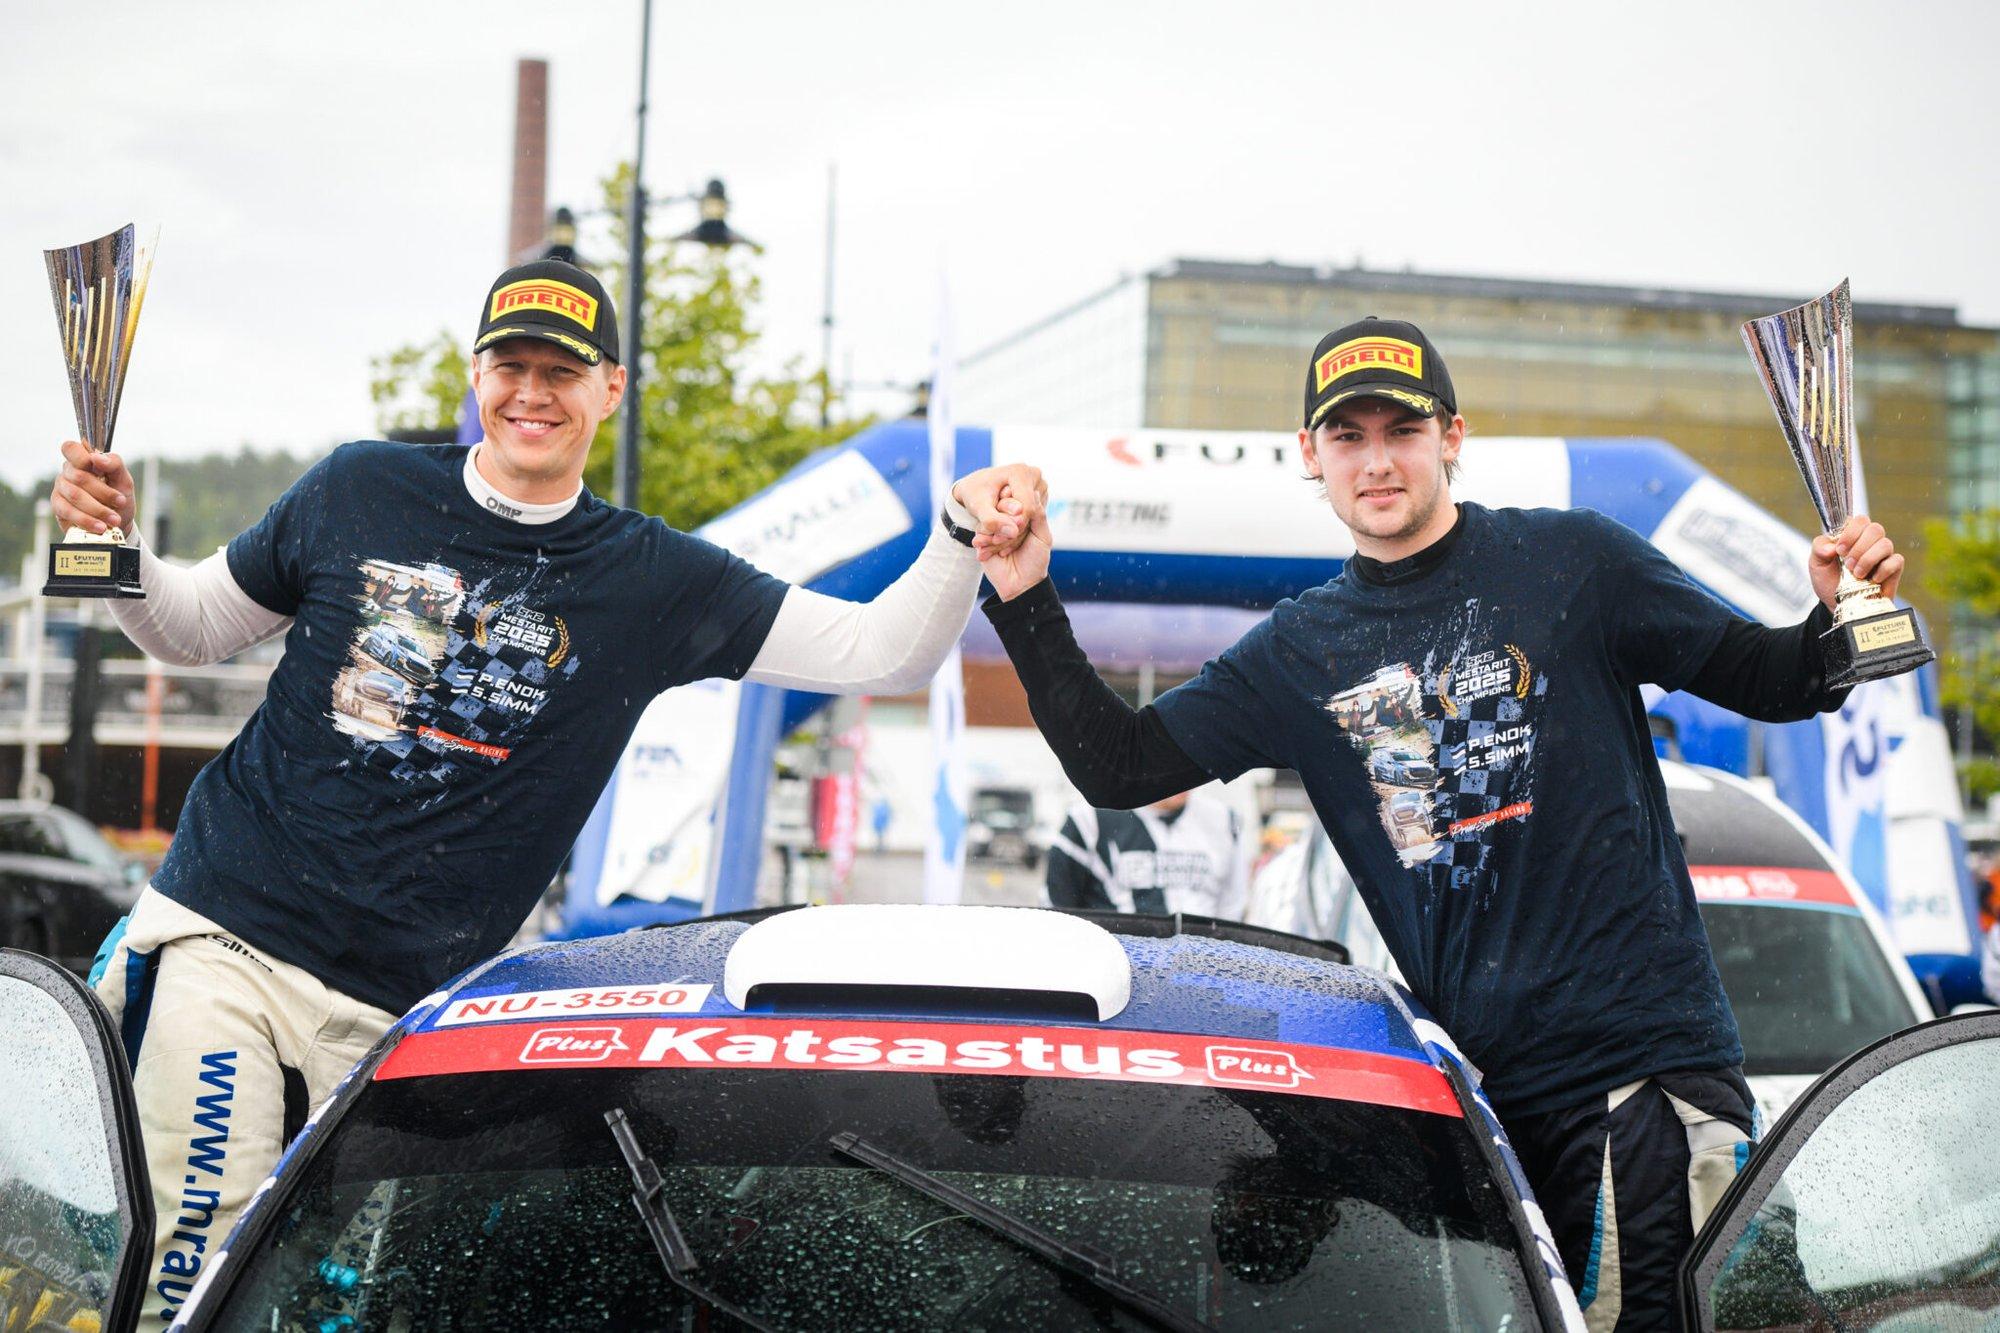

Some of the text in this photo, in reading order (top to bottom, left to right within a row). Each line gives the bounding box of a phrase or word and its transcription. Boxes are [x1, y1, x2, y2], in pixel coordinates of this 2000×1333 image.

[496, 285, 591, 321] PIRELLI
[1322, 342, 1415, 382] PIRELLI
[1155, 441, 1298, 466] FUT
[486, 496, 522, 518] OMP
[493, 620, 552, 648] 2025
[500, 612, 556, 635] MESTARIT
[489, 633, 547, 656] CHAMPIONS
[1455, 657, 1511, 682] MESTARIT
[1455, 668, 1511, 696] 2025
[471, 685, 538, 714] S.SIMM
[477, 673, 548, 701] P.ENOK
[1456, 684, 1512, 706] CHAMPIONS
[1467, 722, 1533, 752] P.ENOK
[1468, 741, 1530, 769] S.SIMM
[456, 989, 688, 1019] NU-3550
[535, 1026, 1290, 1078] Plus Katsastus Plus
